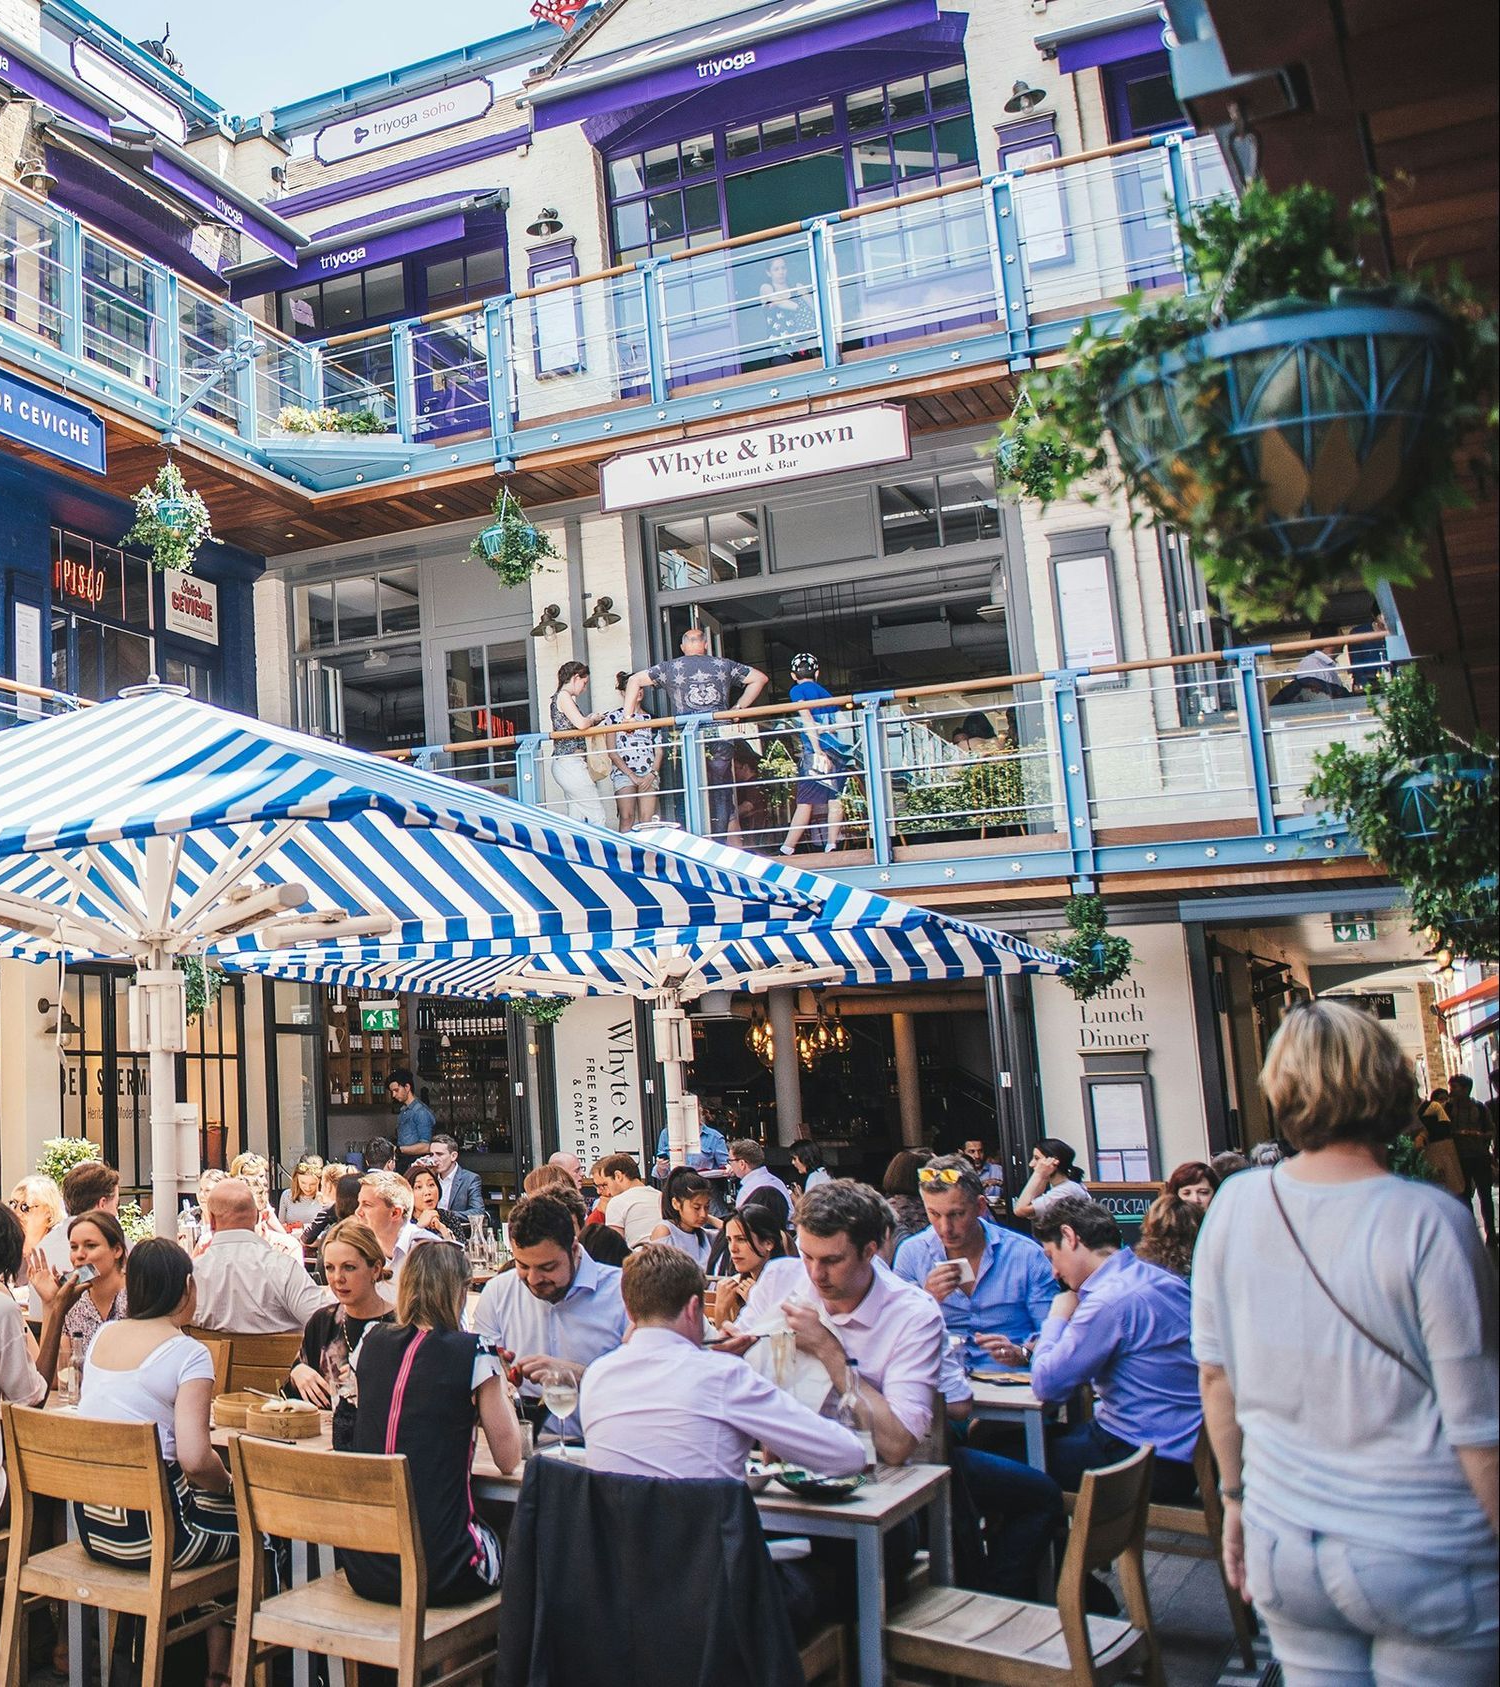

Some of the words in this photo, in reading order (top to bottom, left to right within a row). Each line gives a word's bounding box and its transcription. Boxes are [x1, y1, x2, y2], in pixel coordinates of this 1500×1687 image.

[696, 51, 756, 78] triyoga
[373, 112, 418, 135] triyoga
[422, 100, 456, 120] soho
[215, 195, 244, 225] triyoga
[320, 247, 366, 270] triyoga
[19, 401, 90, 446] CEVICHE
[647, 447, 729, 478] Whyte
[736, 438, 759, 462] &
[768, 425, 855, 456] Brown
[702, 466, 762, 484] Restaurant
[764, 462, 775, 473] &
[778, 458, 799, 471] Bar
[63, 559, 104, 602] PISCO
[171, 591, 213, 623] CEVICHE
[1080, 1003, 1144, 1024] Lunch
[1080, 1028, 1150, 1047] Dinner
[585, 1058, 597, 1090] FREE
[600, 1019, 634, 1106] Whyte
[96, 1067, 151, 1096] SERM
[572, 1078, 582, 1086] &
[573, 1092, 585, 1133] CRAFT
[588, 1096, 600, 1140] RANGE
[612, 1116, 634, 1138] &
